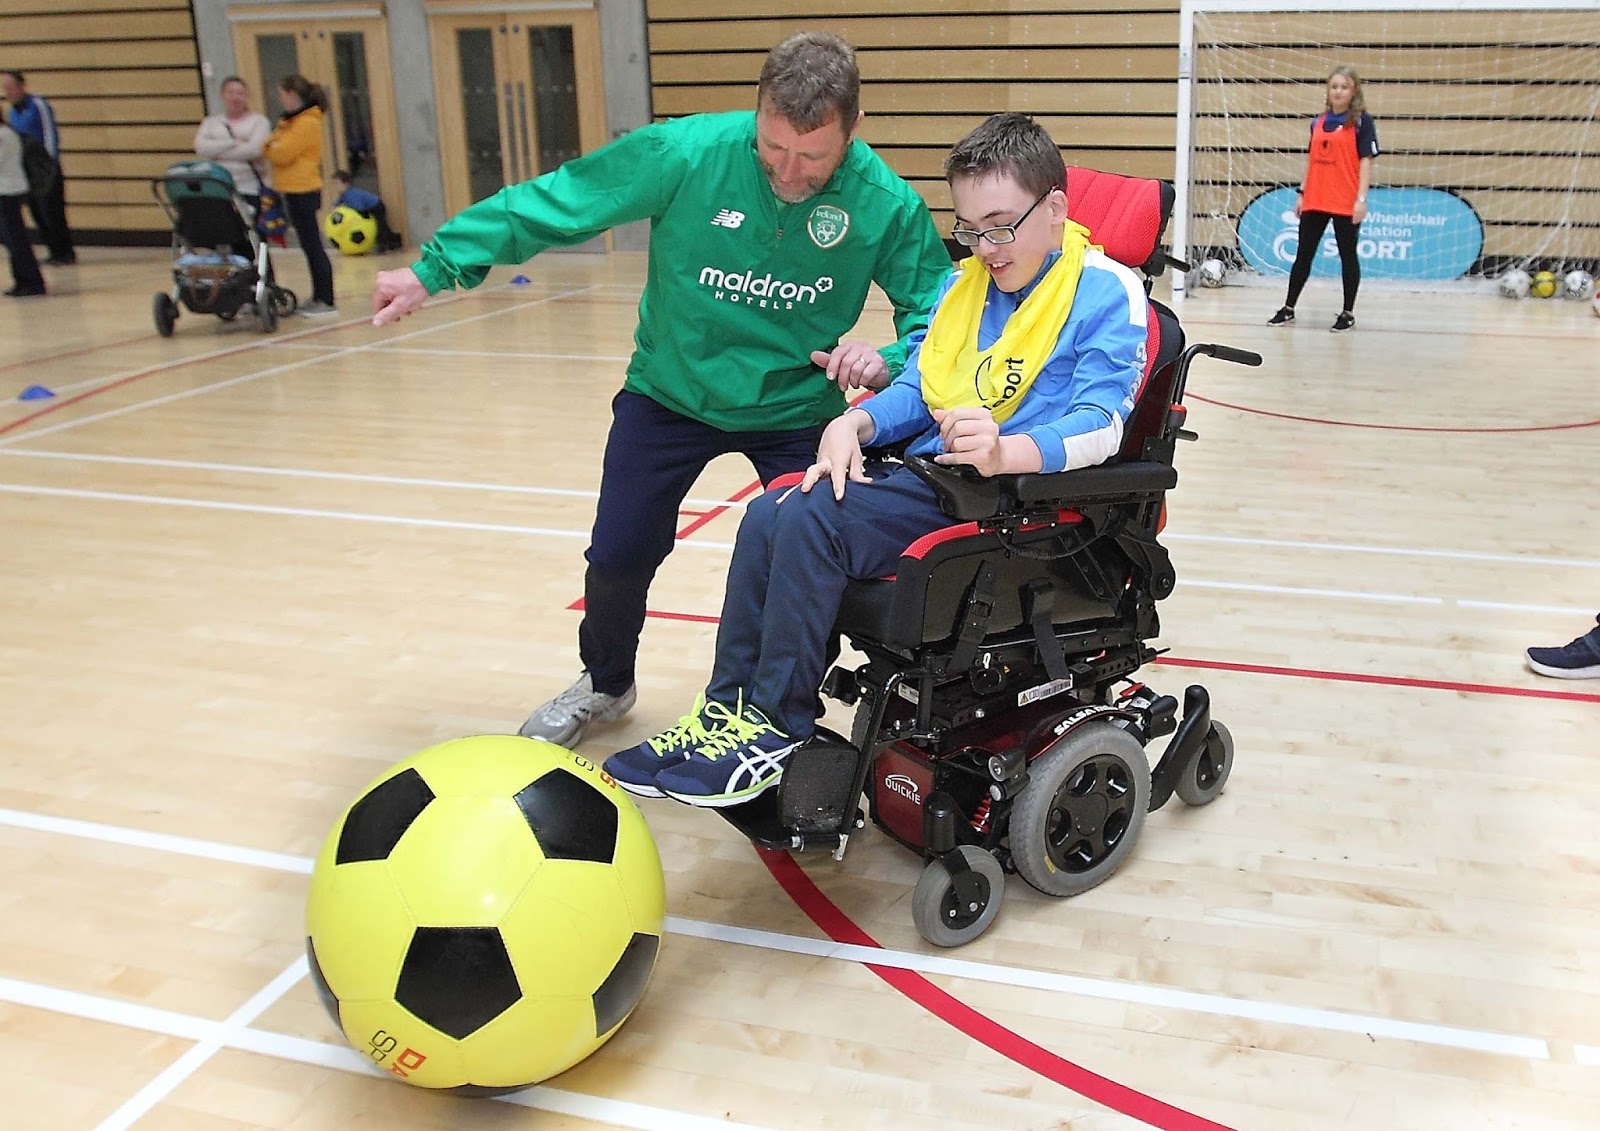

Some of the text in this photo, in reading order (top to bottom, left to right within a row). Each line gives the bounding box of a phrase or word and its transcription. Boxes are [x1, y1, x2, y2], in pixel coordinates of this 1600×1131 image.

[1324, 238, 1412, 260] SORT
[699, 266, 817, 304] maldron
[714, 290, 793, 310] HOTELS
[1053, 708, 1096, 736] SALSA
[885, 777, 921, 805] QUICKIE
